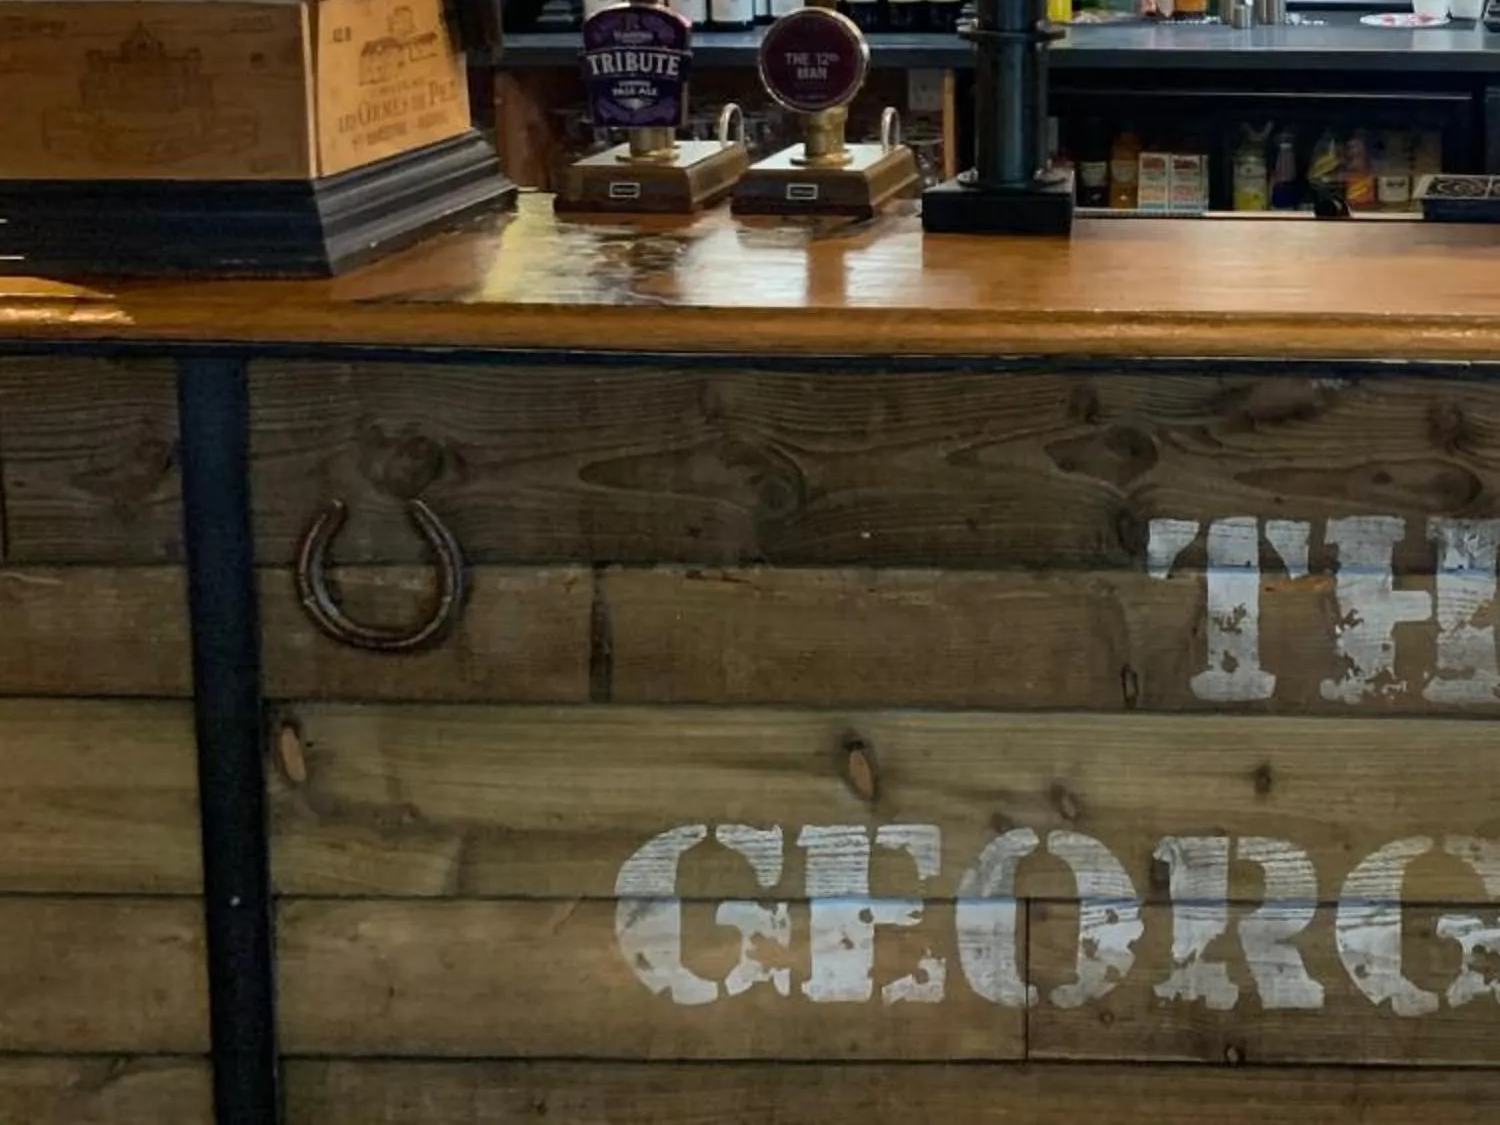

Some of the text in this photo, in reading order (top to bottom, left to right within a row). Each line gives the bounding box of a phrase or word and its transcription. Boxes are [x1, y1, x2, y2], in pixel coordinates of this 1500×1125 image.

[586, 51, 681, 76] TRIBUTE
[784, 52, 809, 66] THE
[796, 66, 828, 81] MAN
